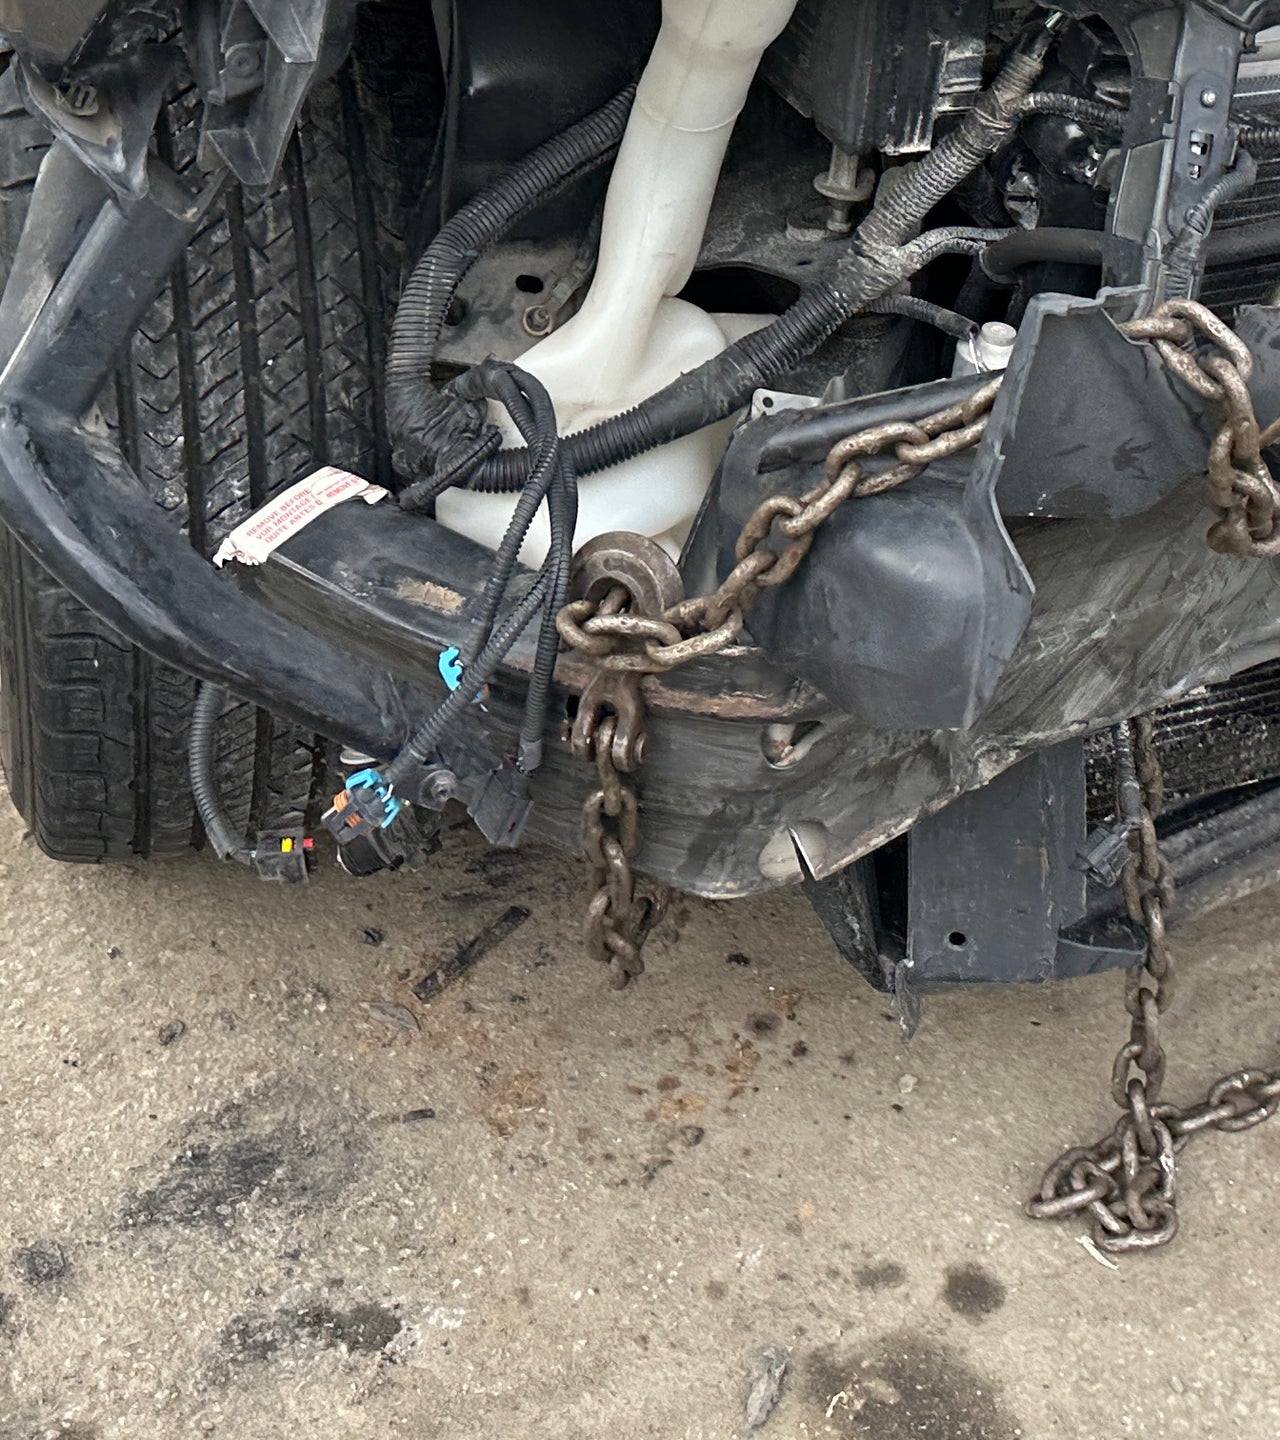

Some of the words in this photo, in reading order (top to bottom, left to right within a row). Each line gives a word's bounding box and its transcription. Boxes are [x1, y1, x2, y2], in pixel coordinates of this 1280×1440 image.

[246, 510, 280, 537] REMOVE
[279, 488, 312, 512] BEFORE
[264, 524, 289, 543] QUITE
